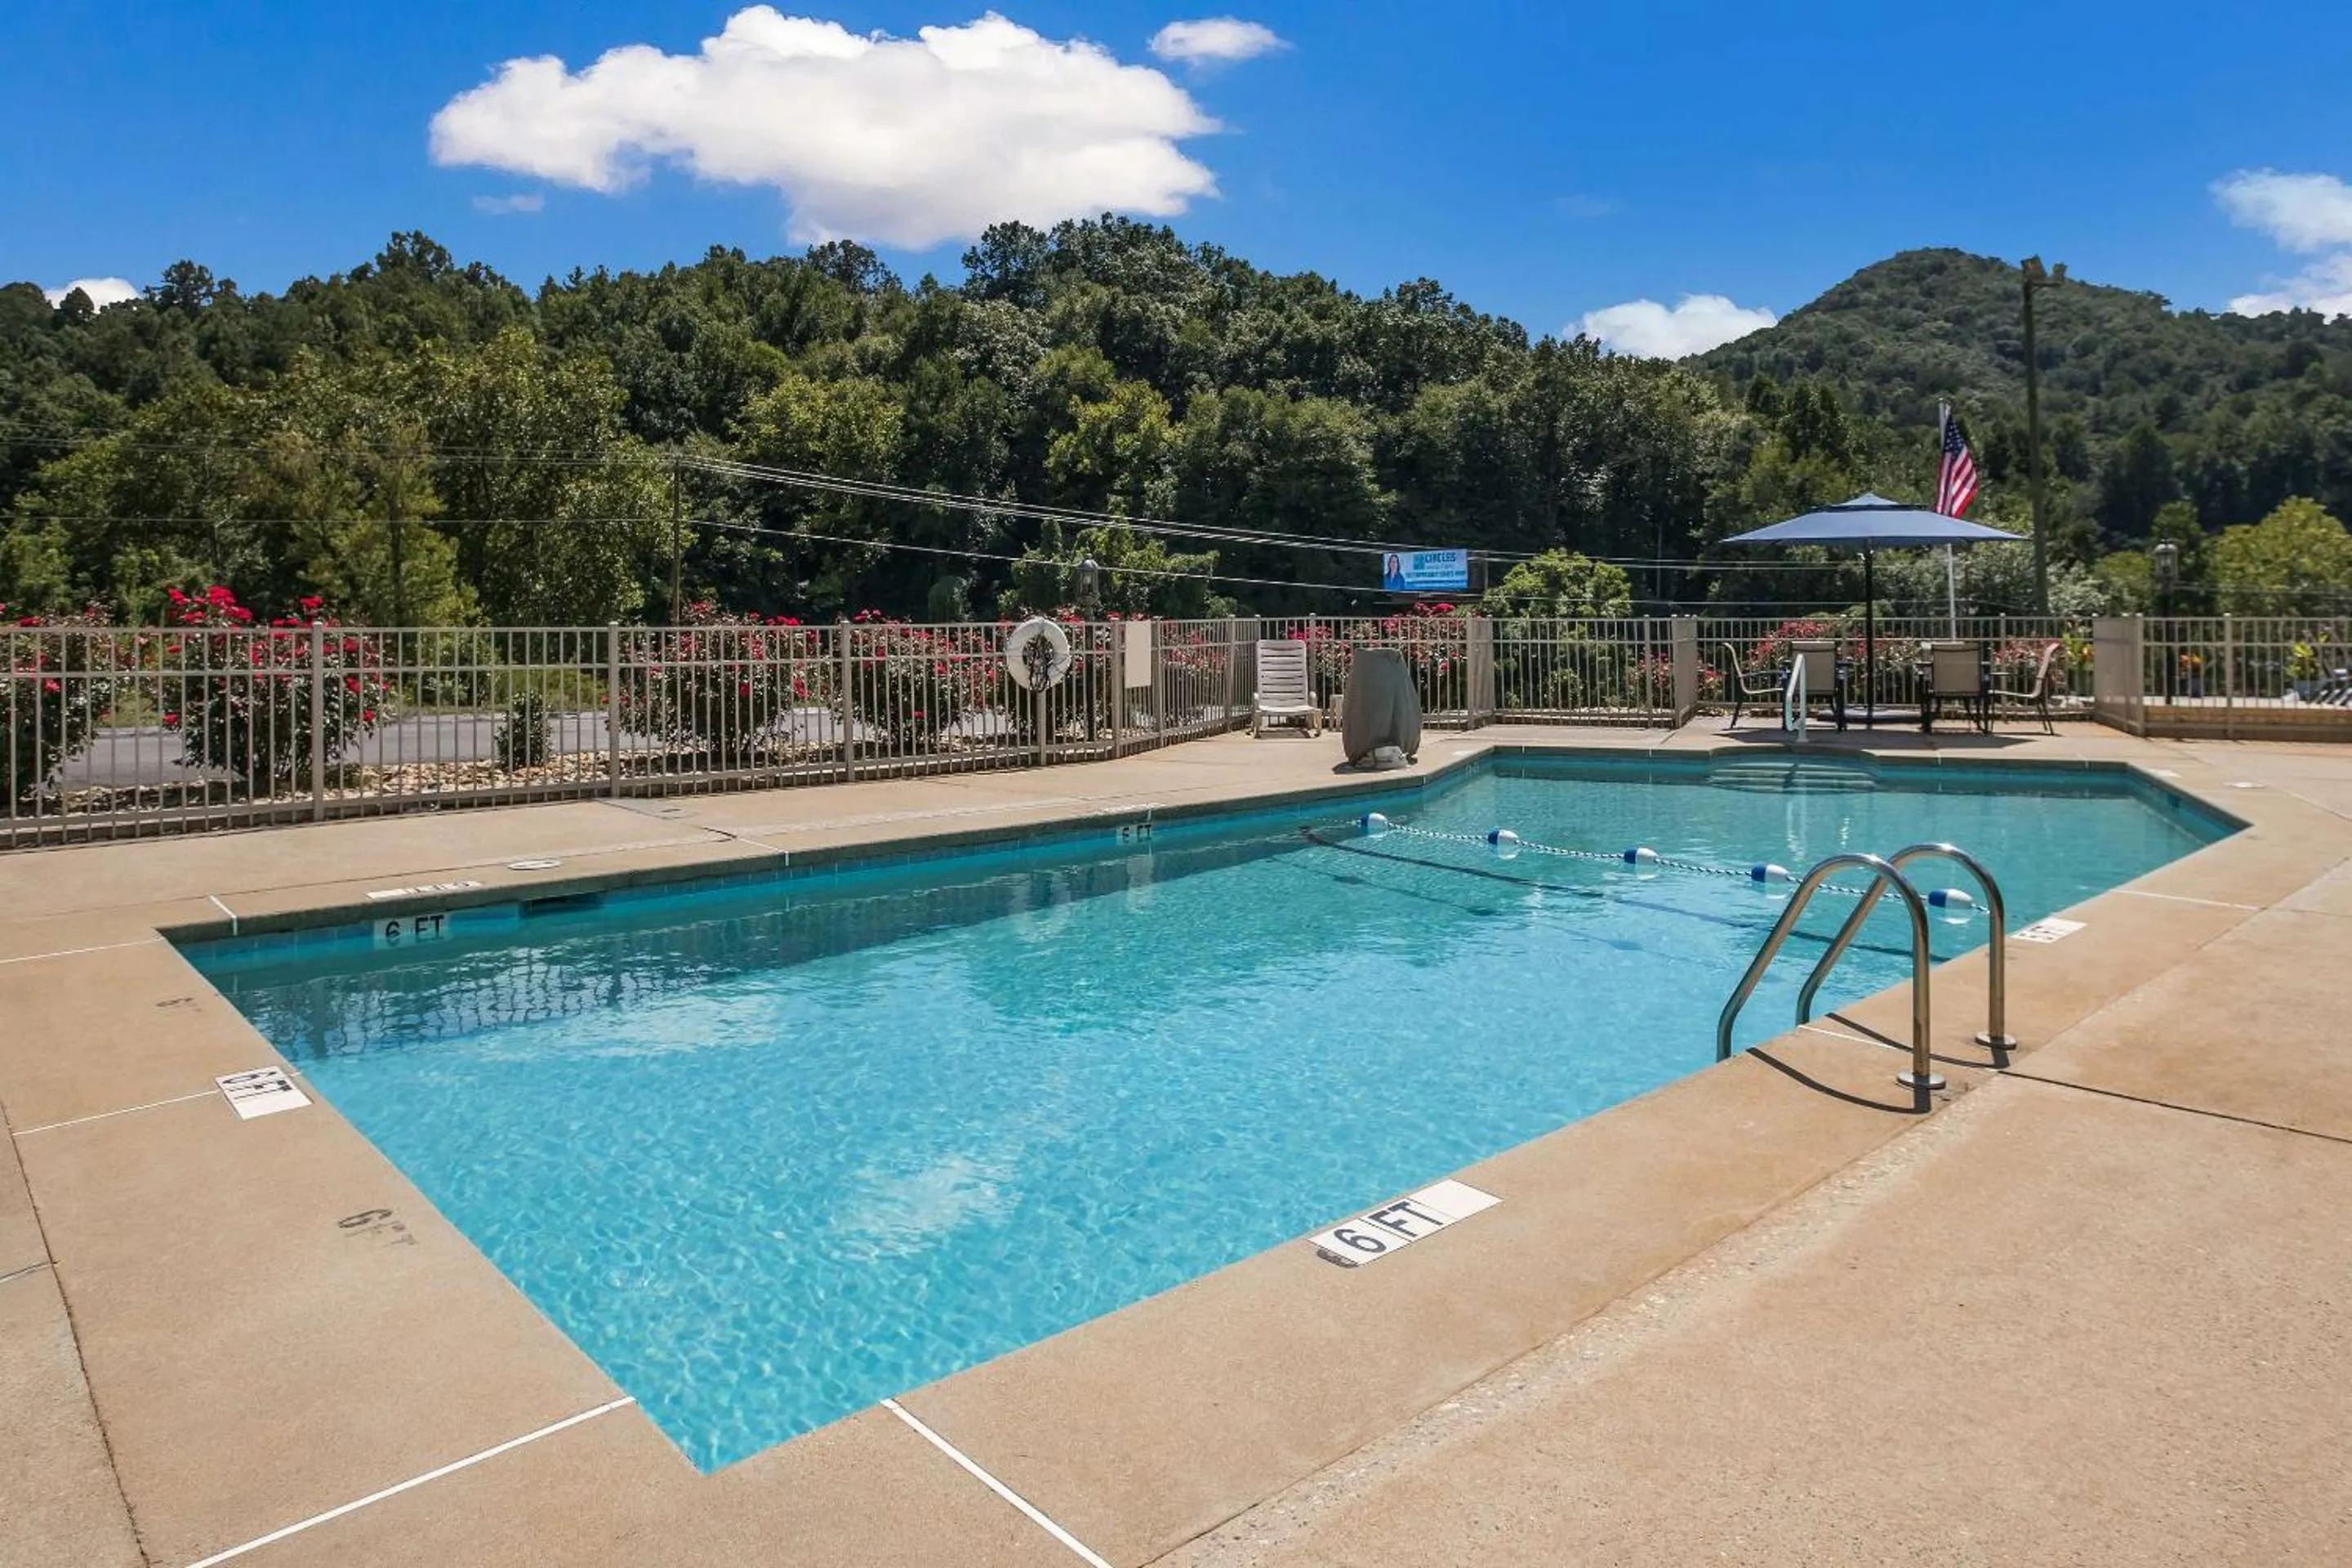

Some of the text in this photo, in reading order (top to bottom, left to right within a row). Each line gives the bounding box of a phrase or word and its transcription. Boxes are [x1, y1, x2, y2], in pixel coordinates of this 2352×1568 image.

[415, 914, 444, 939] FT
[228, 1079, 292, 1100] FT
[1334, 1200, 1444, 1253] 6 FT
